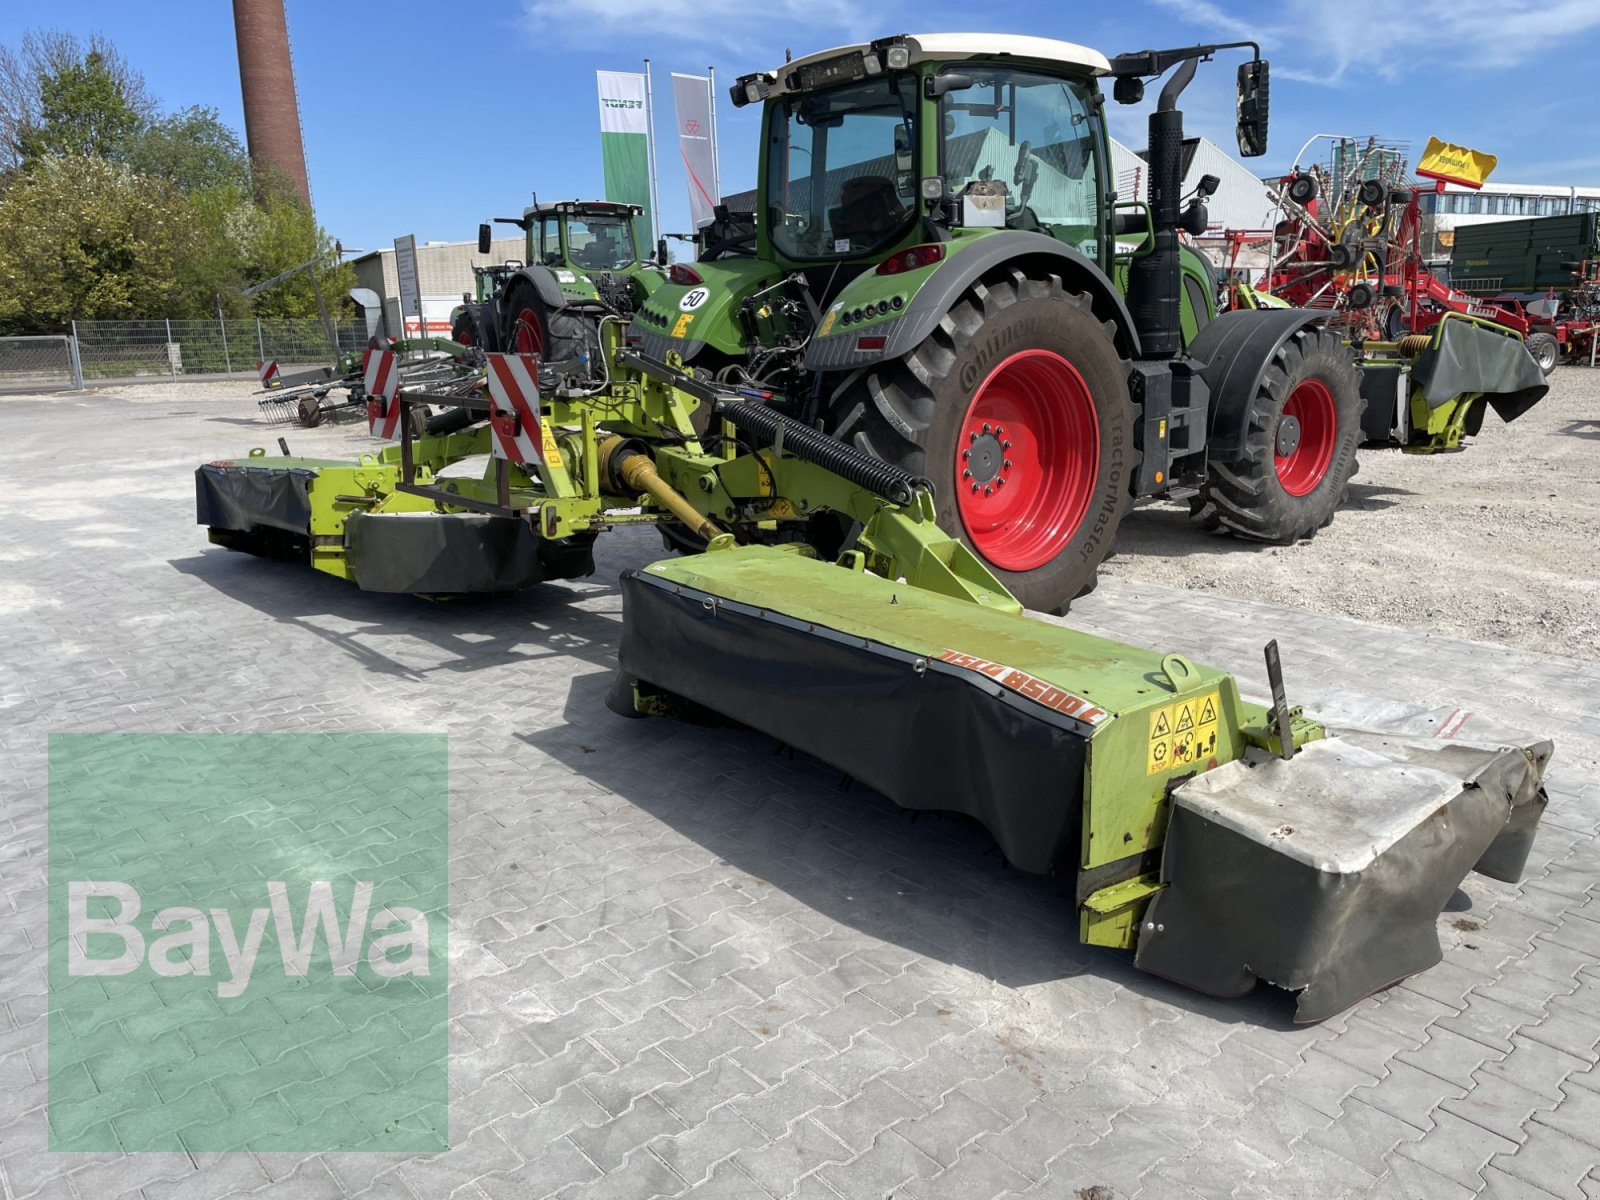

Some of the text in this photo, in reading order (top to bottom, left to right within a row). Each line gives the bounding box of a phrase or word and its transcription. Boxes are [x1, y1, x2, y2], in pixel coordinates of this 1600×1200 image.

[683, 291, 705, 307] 50
[1080, 408, 1125, 563] TractorMaster
[1001, 670, 1087, 715] 8500
